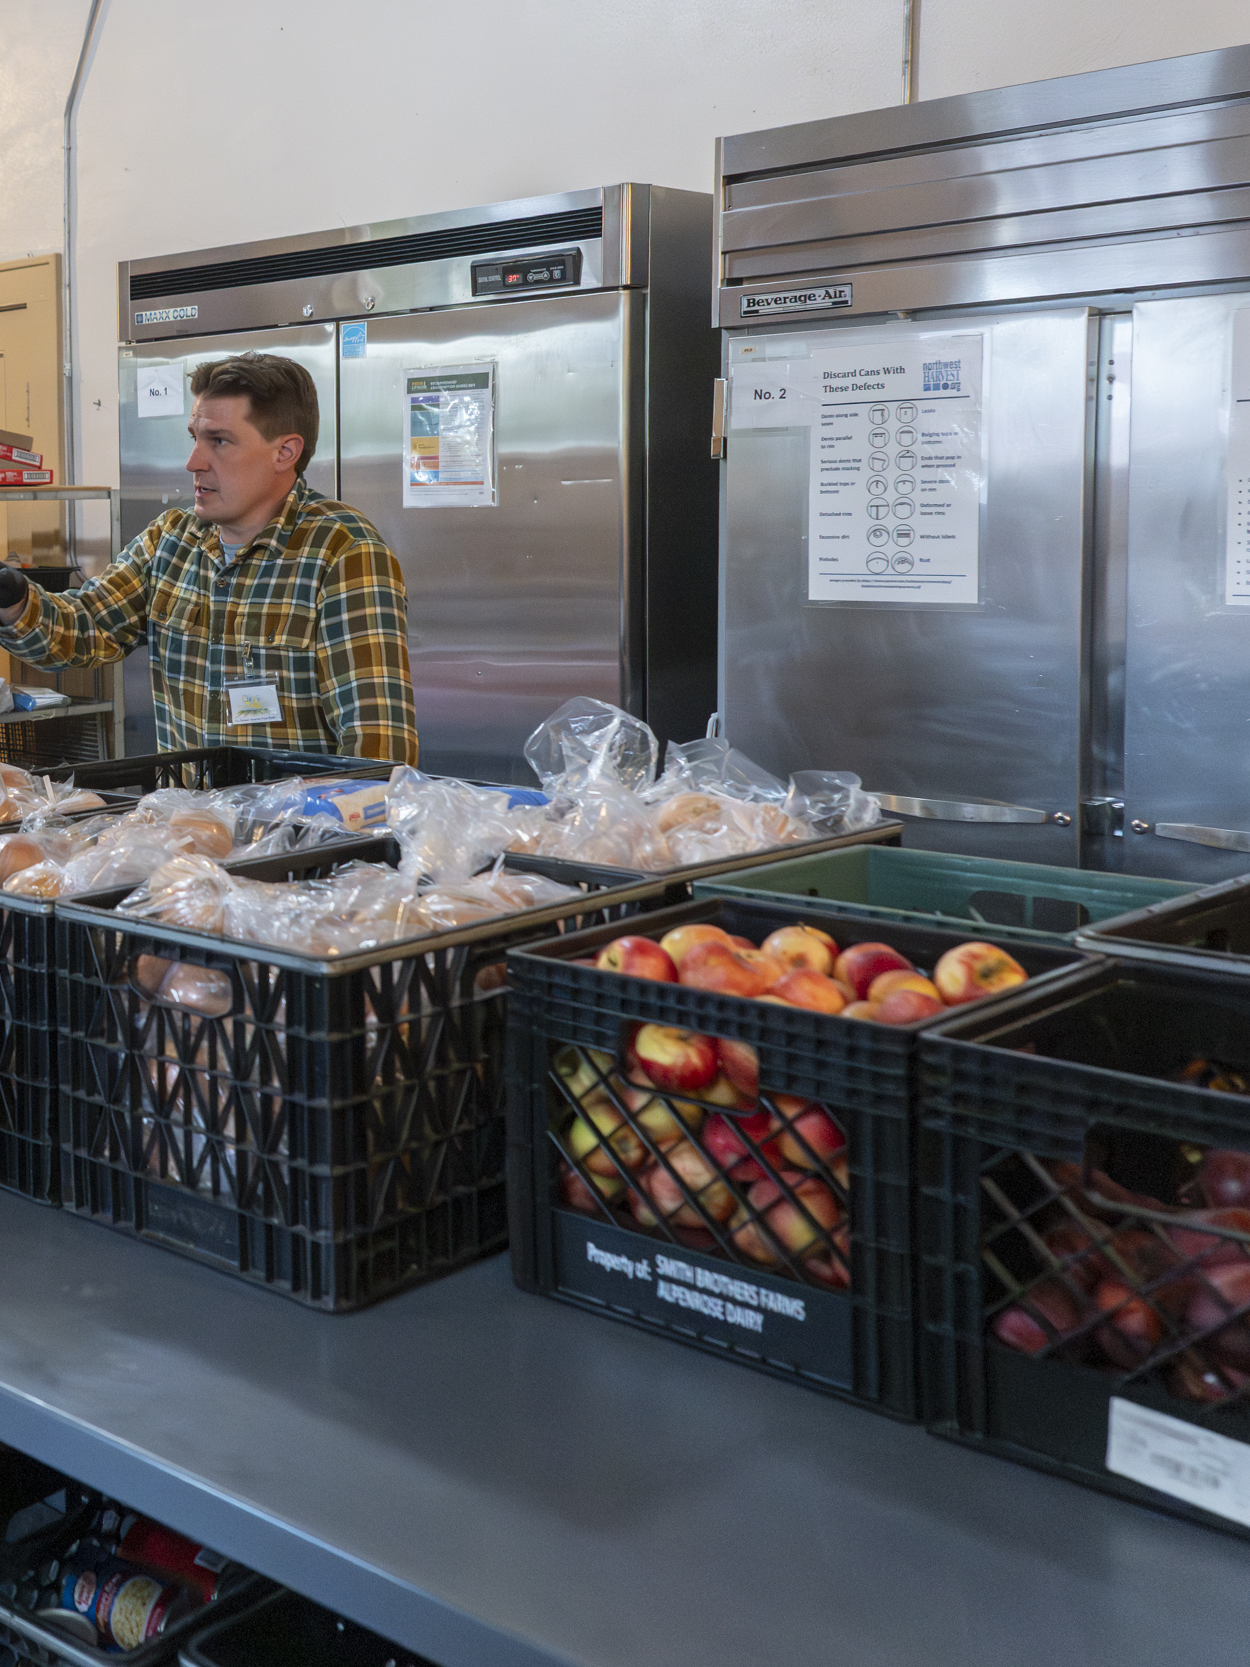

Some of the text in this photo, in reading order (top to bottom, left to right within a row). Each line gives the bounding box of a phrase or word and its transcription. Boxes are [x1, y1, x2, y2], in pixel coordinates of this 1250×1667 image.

[144, 307, 197, 323] MAXX COLD
[923, 359, 961, 371] northwest
[823, 366, 906, 379] Discard Cans With
[923, 370, 961, 383] HARVEST
[149, 387, 168, 397] No. 1
[753, 388, 787, 400] No. 2
[822, 382, 885, 393] These Defects
[586, 1241, 634, 1279] Property
[655, 1254, 694, 1285] SMITH
[695, 1267, 759, 1307] BROTHERS
[759, 1287, 806, 1321] FARMS
[725, 1301, 764, 1333] DAIRY
